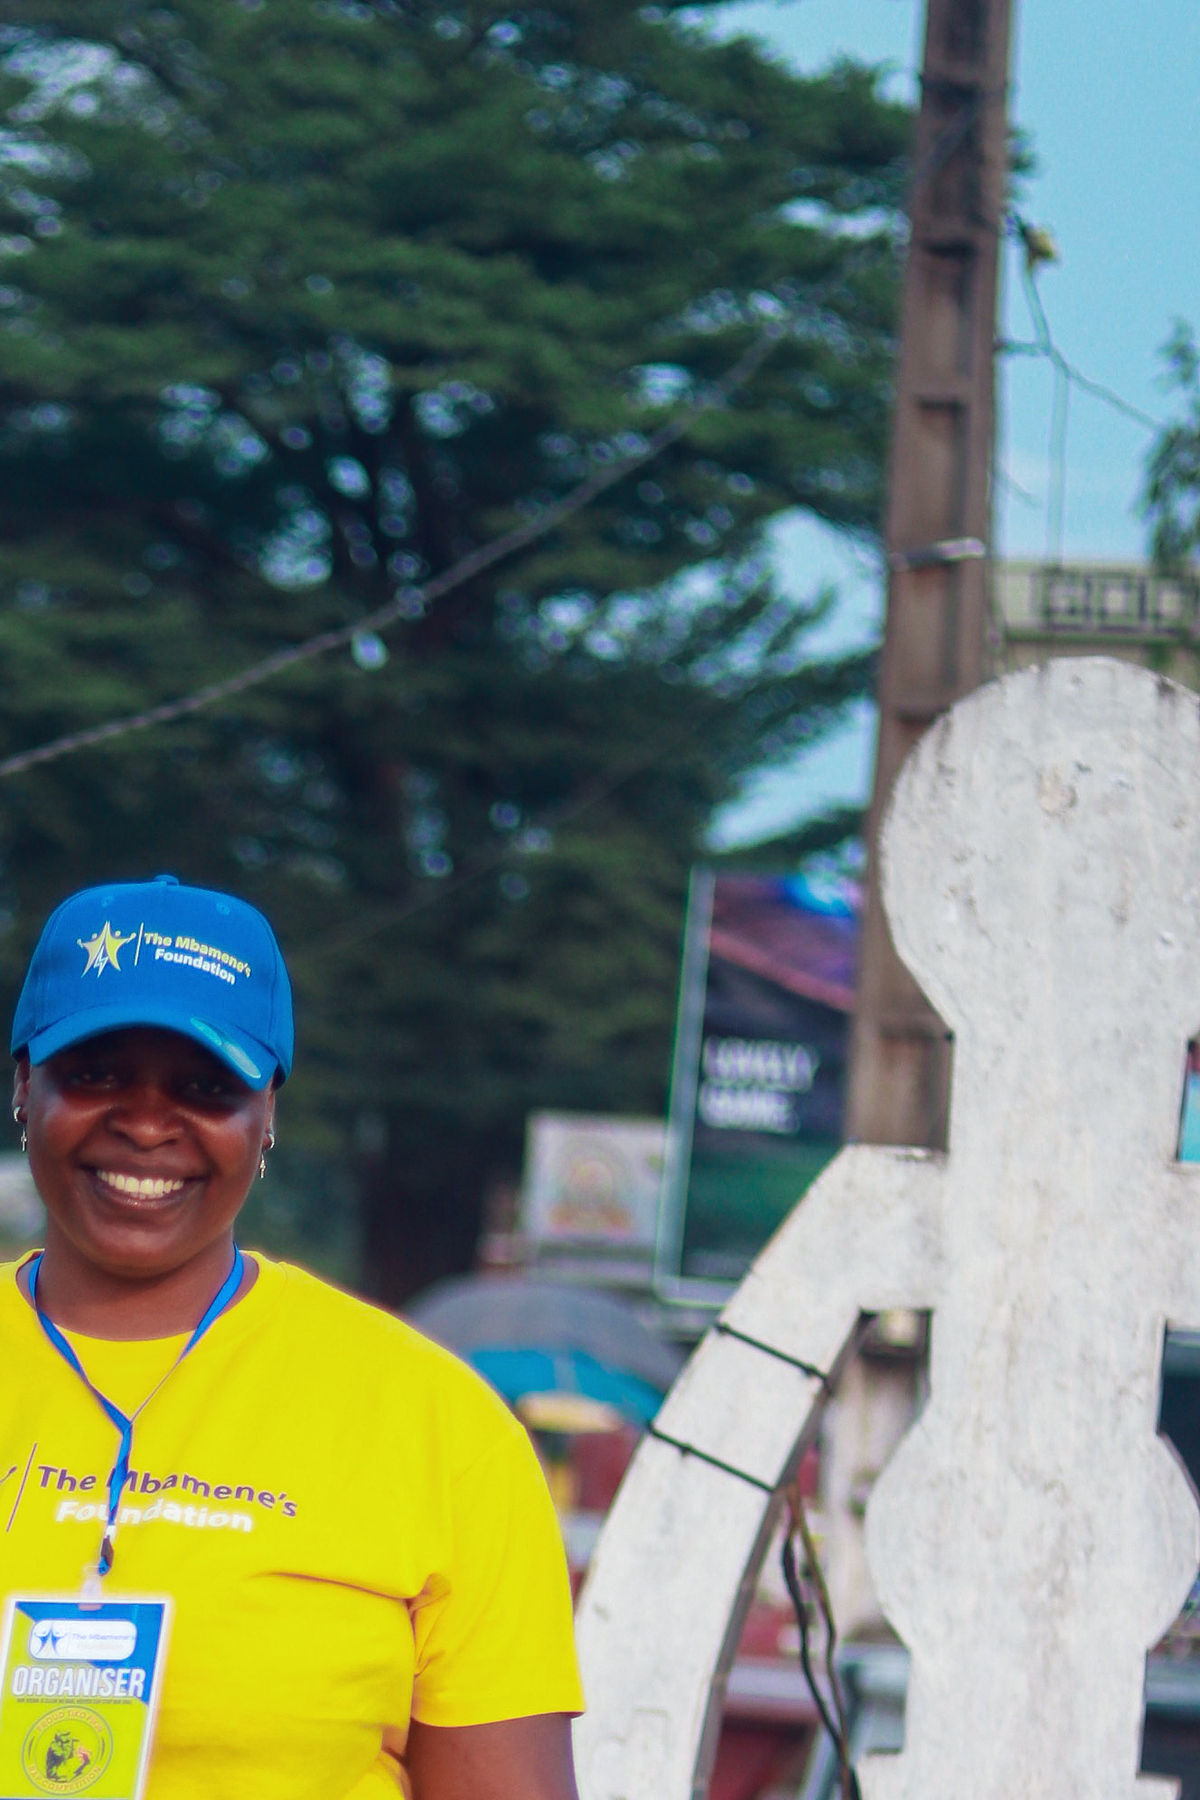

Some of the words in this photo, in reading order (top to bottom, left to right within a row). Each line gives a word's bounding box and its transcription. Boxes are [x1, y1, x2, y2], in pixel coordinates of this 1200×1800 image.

[144, 932, 172, 946] The
[175, 936, 251, 978] Mbamene's
[155, 948, 236, 985] Foundation
[38, 1465, 97, 1492] The
[12, 1666, 146, 1698] ORGANISER
